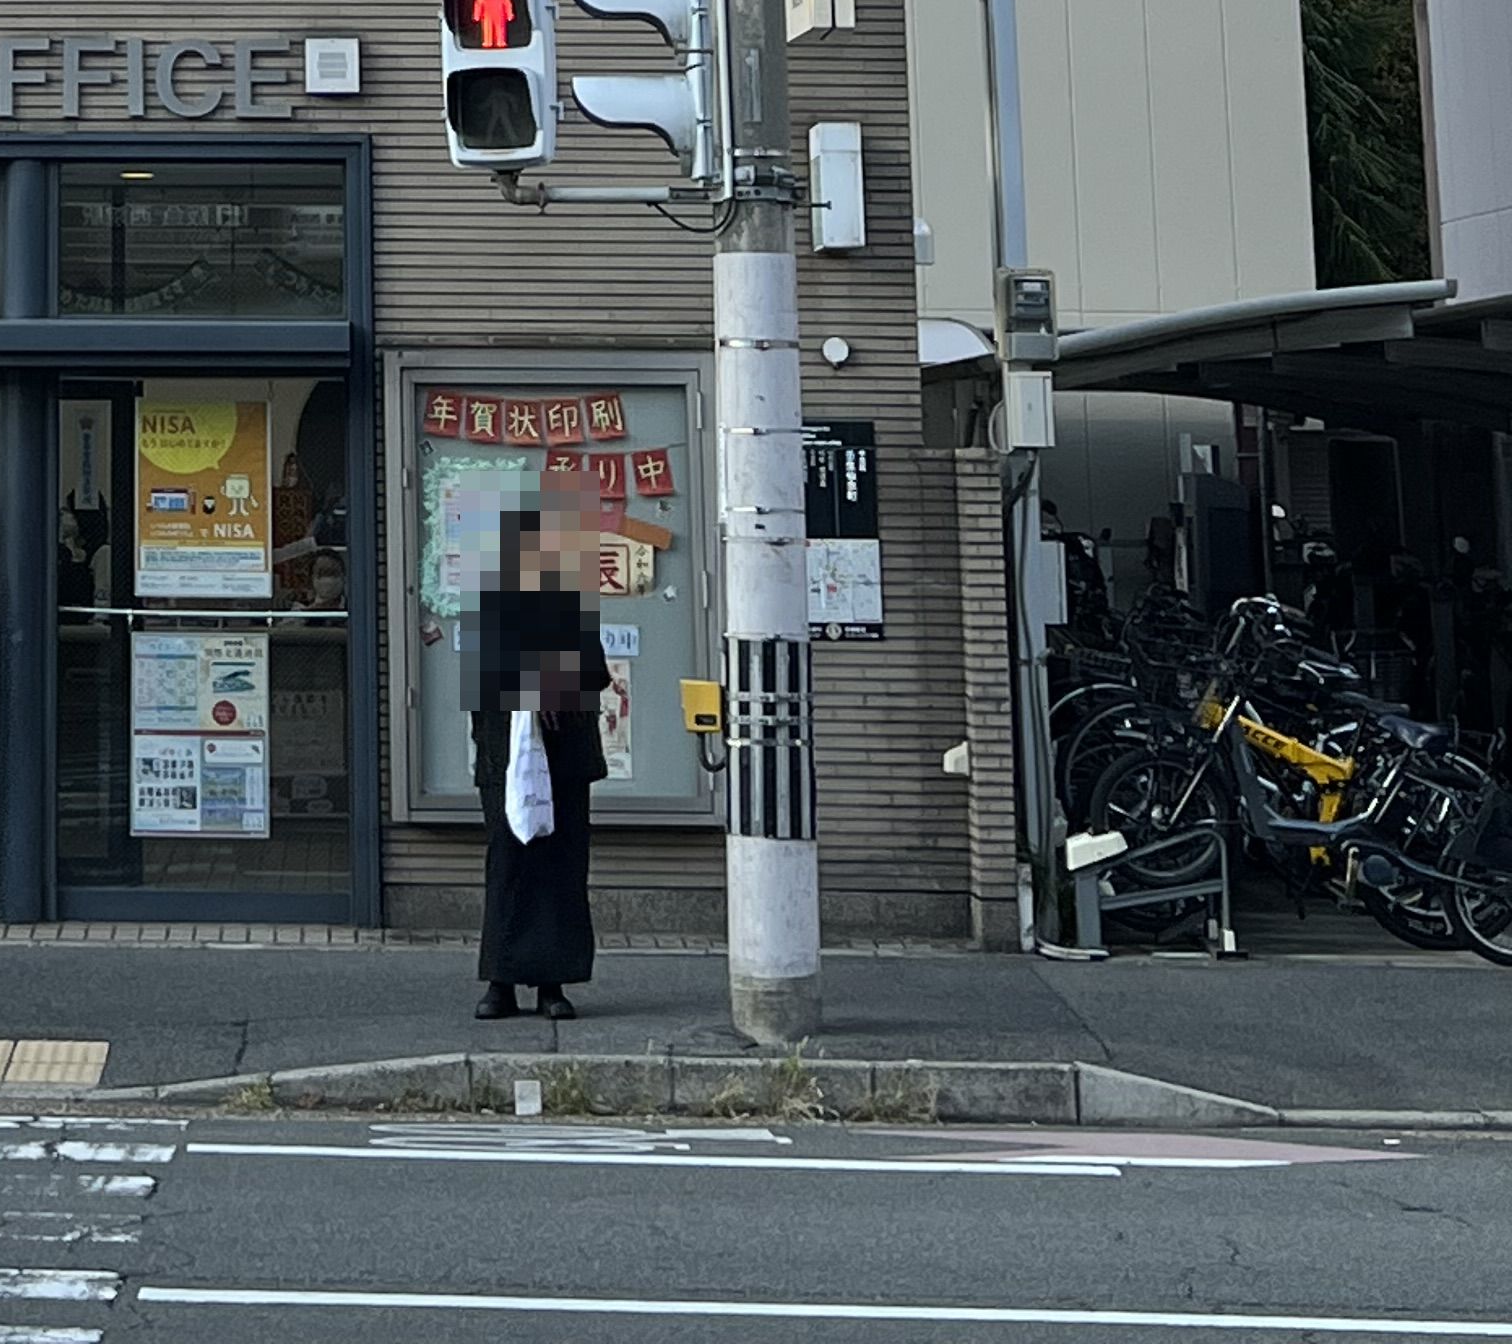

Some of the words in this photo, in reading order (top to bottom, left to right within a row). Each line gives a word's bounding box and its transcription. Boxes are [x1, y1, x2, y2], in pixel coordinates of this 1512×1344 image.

[141, 414, 197, 435] NISA
[427, 395, 624, 438] 年賀状印刷
[213, 523, 255, 539] NISA
